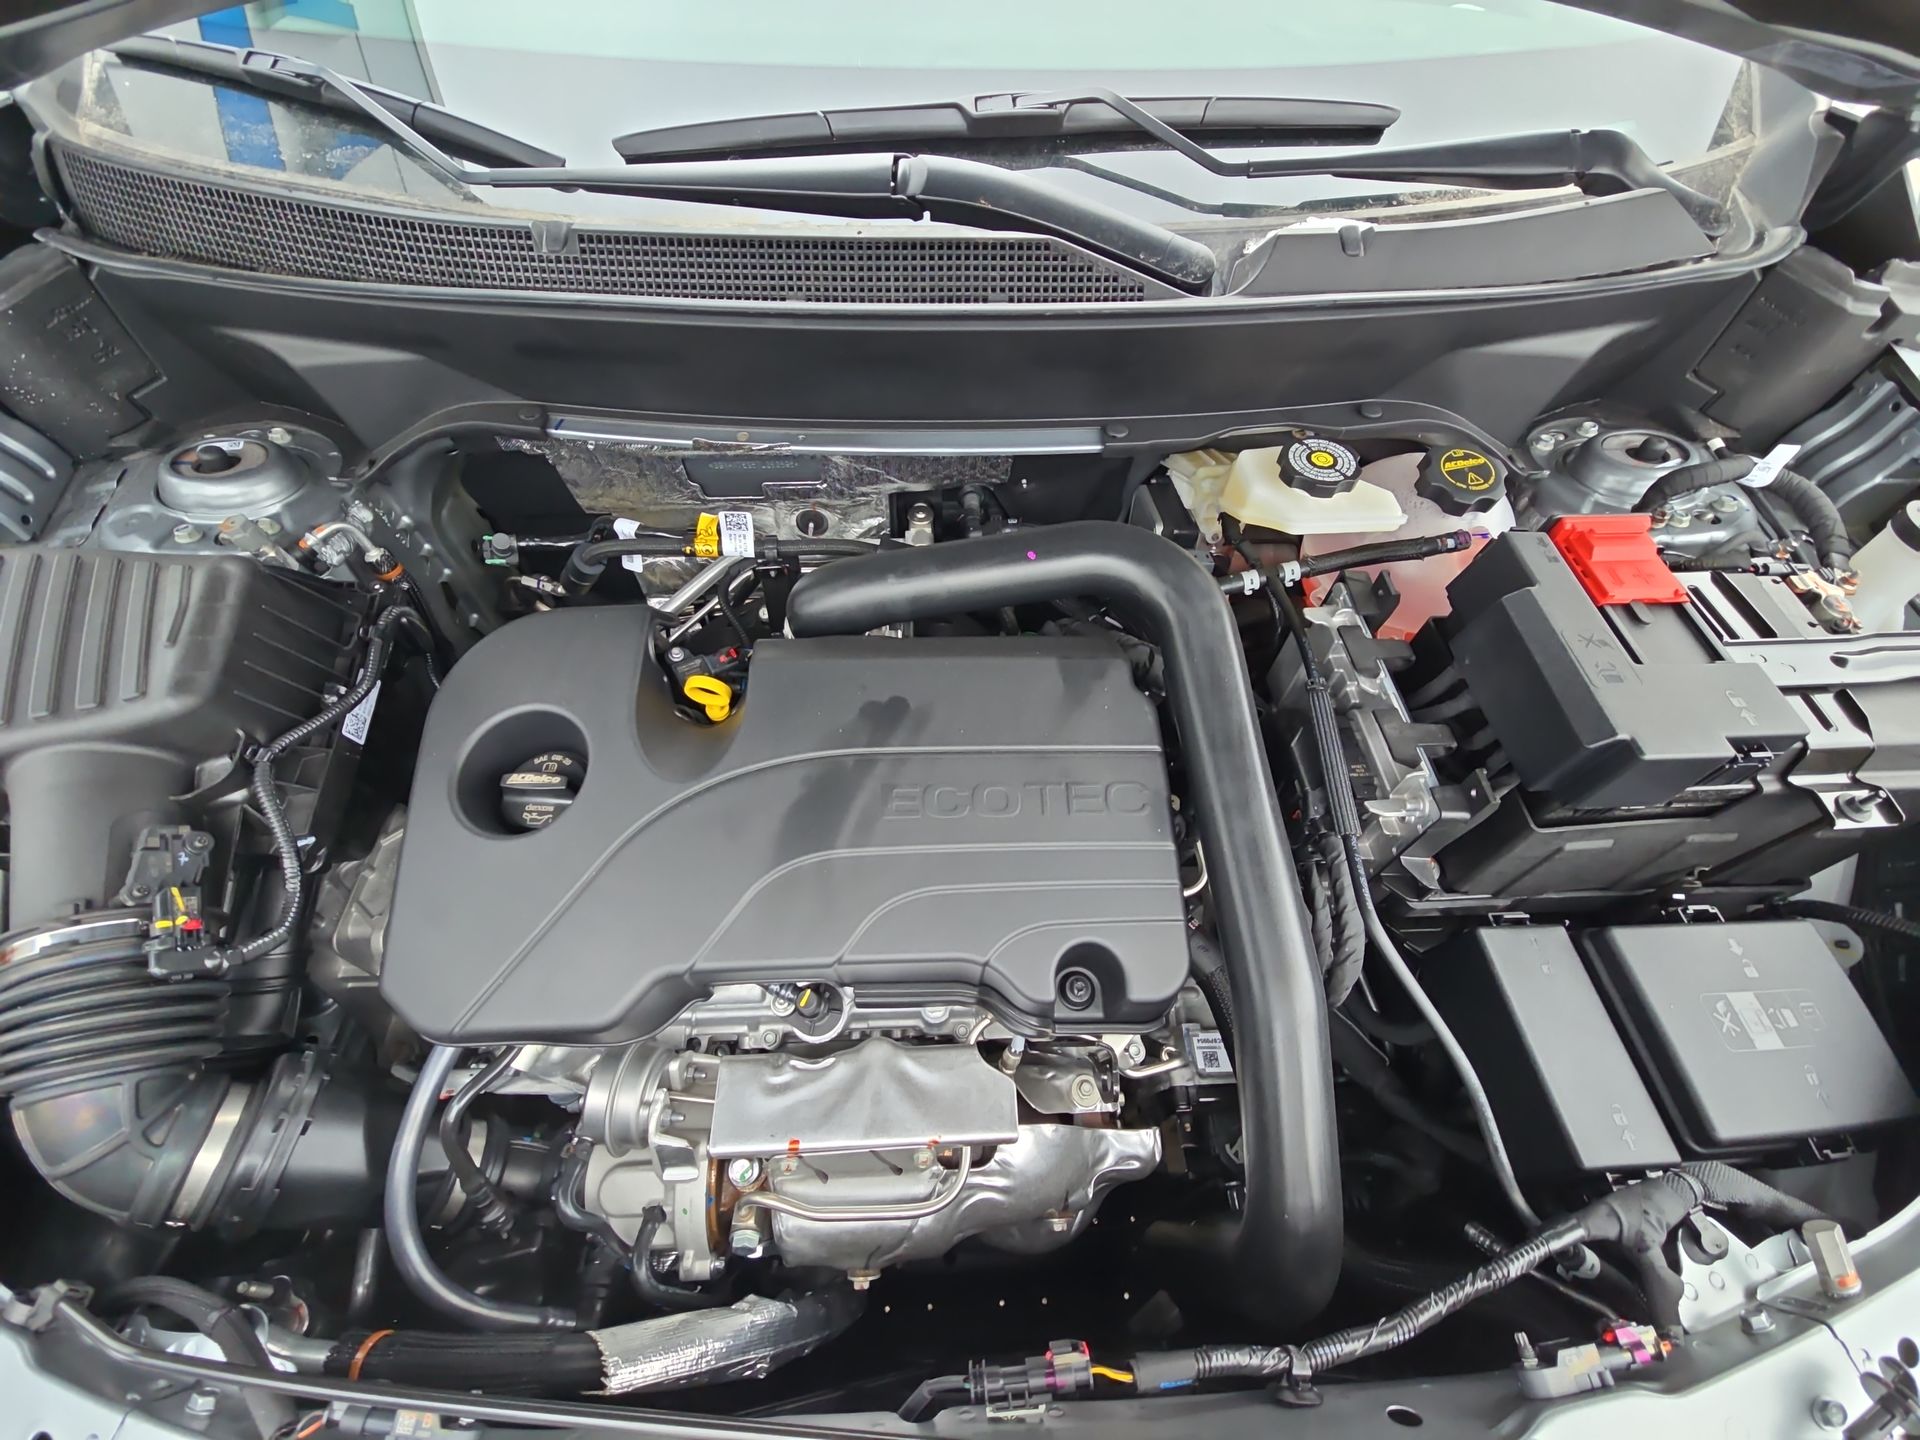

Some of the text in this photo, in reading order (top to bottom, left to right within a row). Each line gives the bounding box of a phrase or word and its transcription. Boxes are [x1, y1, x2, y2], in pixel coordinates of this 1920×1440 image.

[1444, 458, 1485, 471] ACDelco
[505, 773, 562, 785] ACDelco
[880, 780, 1150, 820] ECOTEC
